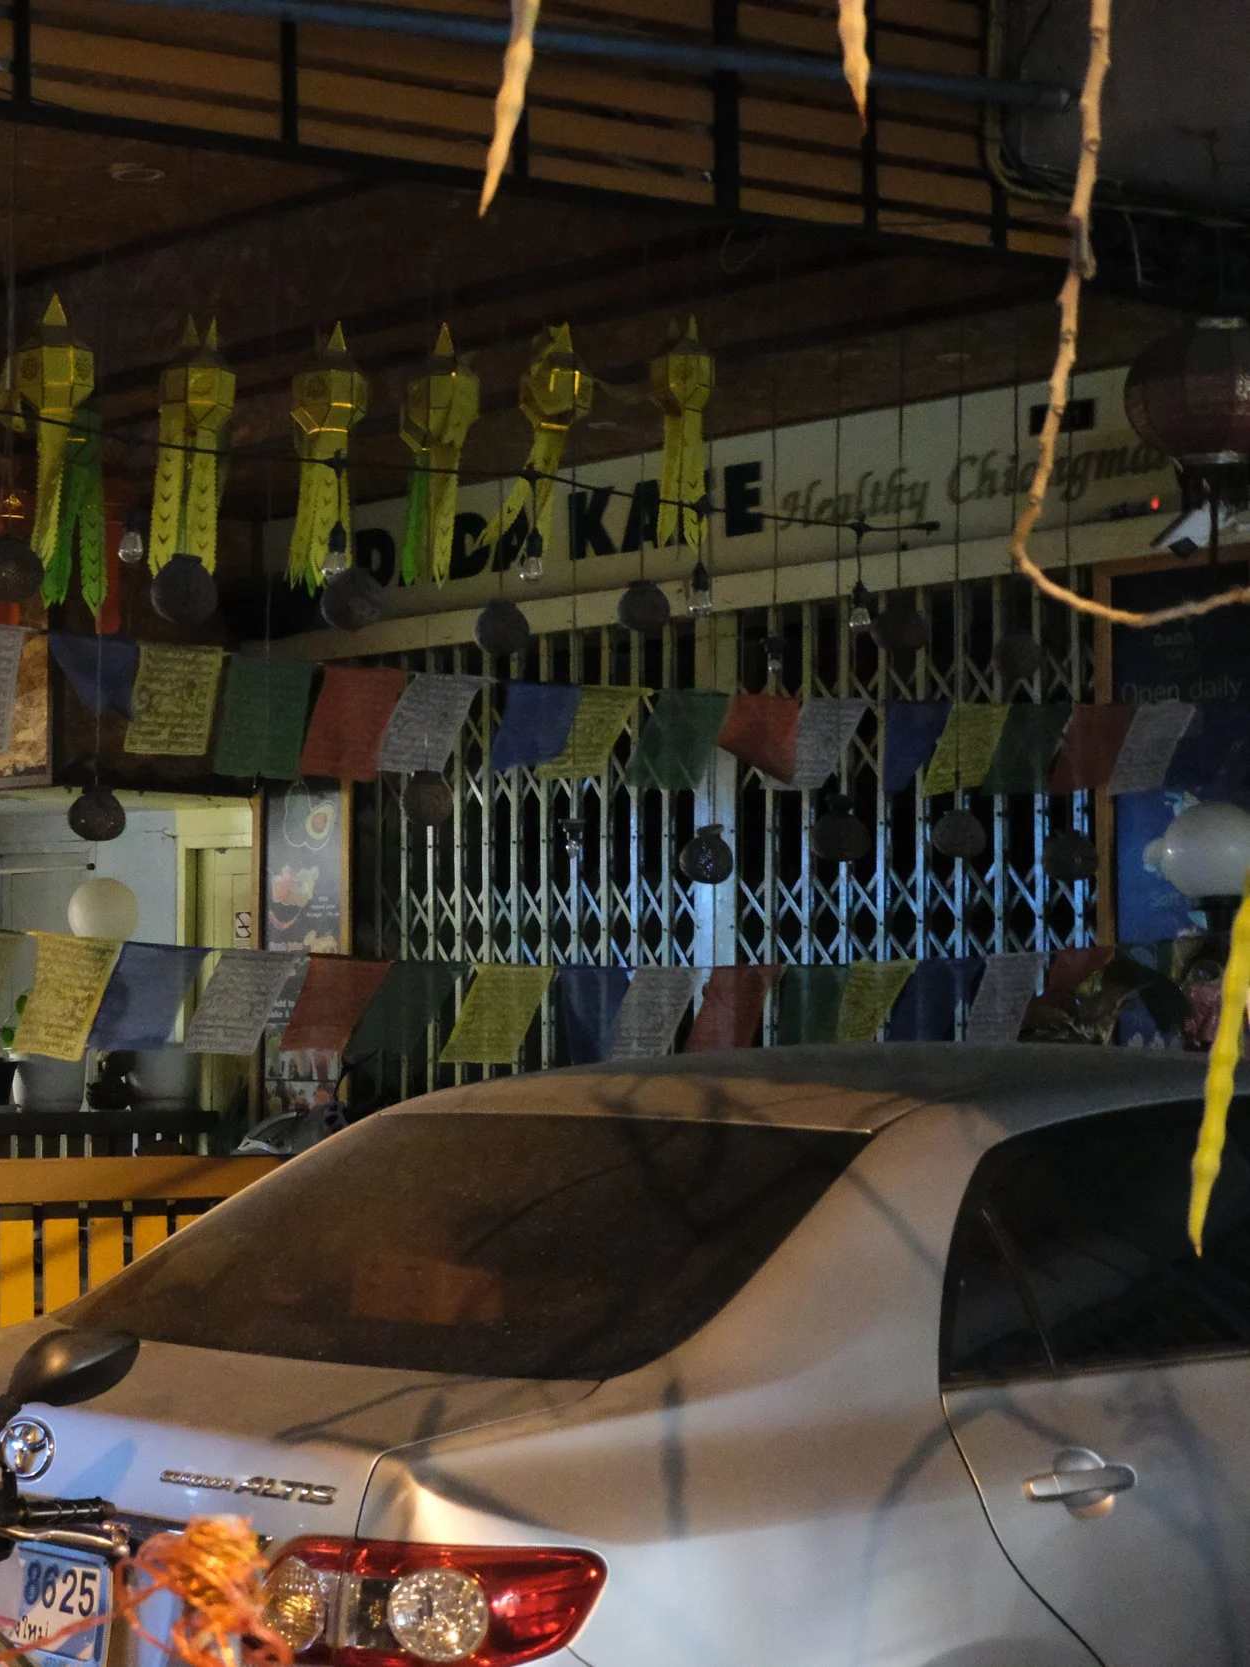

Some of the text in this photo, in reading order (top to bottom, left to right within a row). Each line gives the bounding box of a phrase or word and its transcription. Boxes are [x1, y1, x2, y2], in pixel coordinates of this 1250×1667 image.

[354, 461, 762, 588] DDA KAE
[779, 466, 931, 530] Healthy
[234, 1475, 338, 1506] ALTIS
[23, 1559, 97, 1617] 8625
